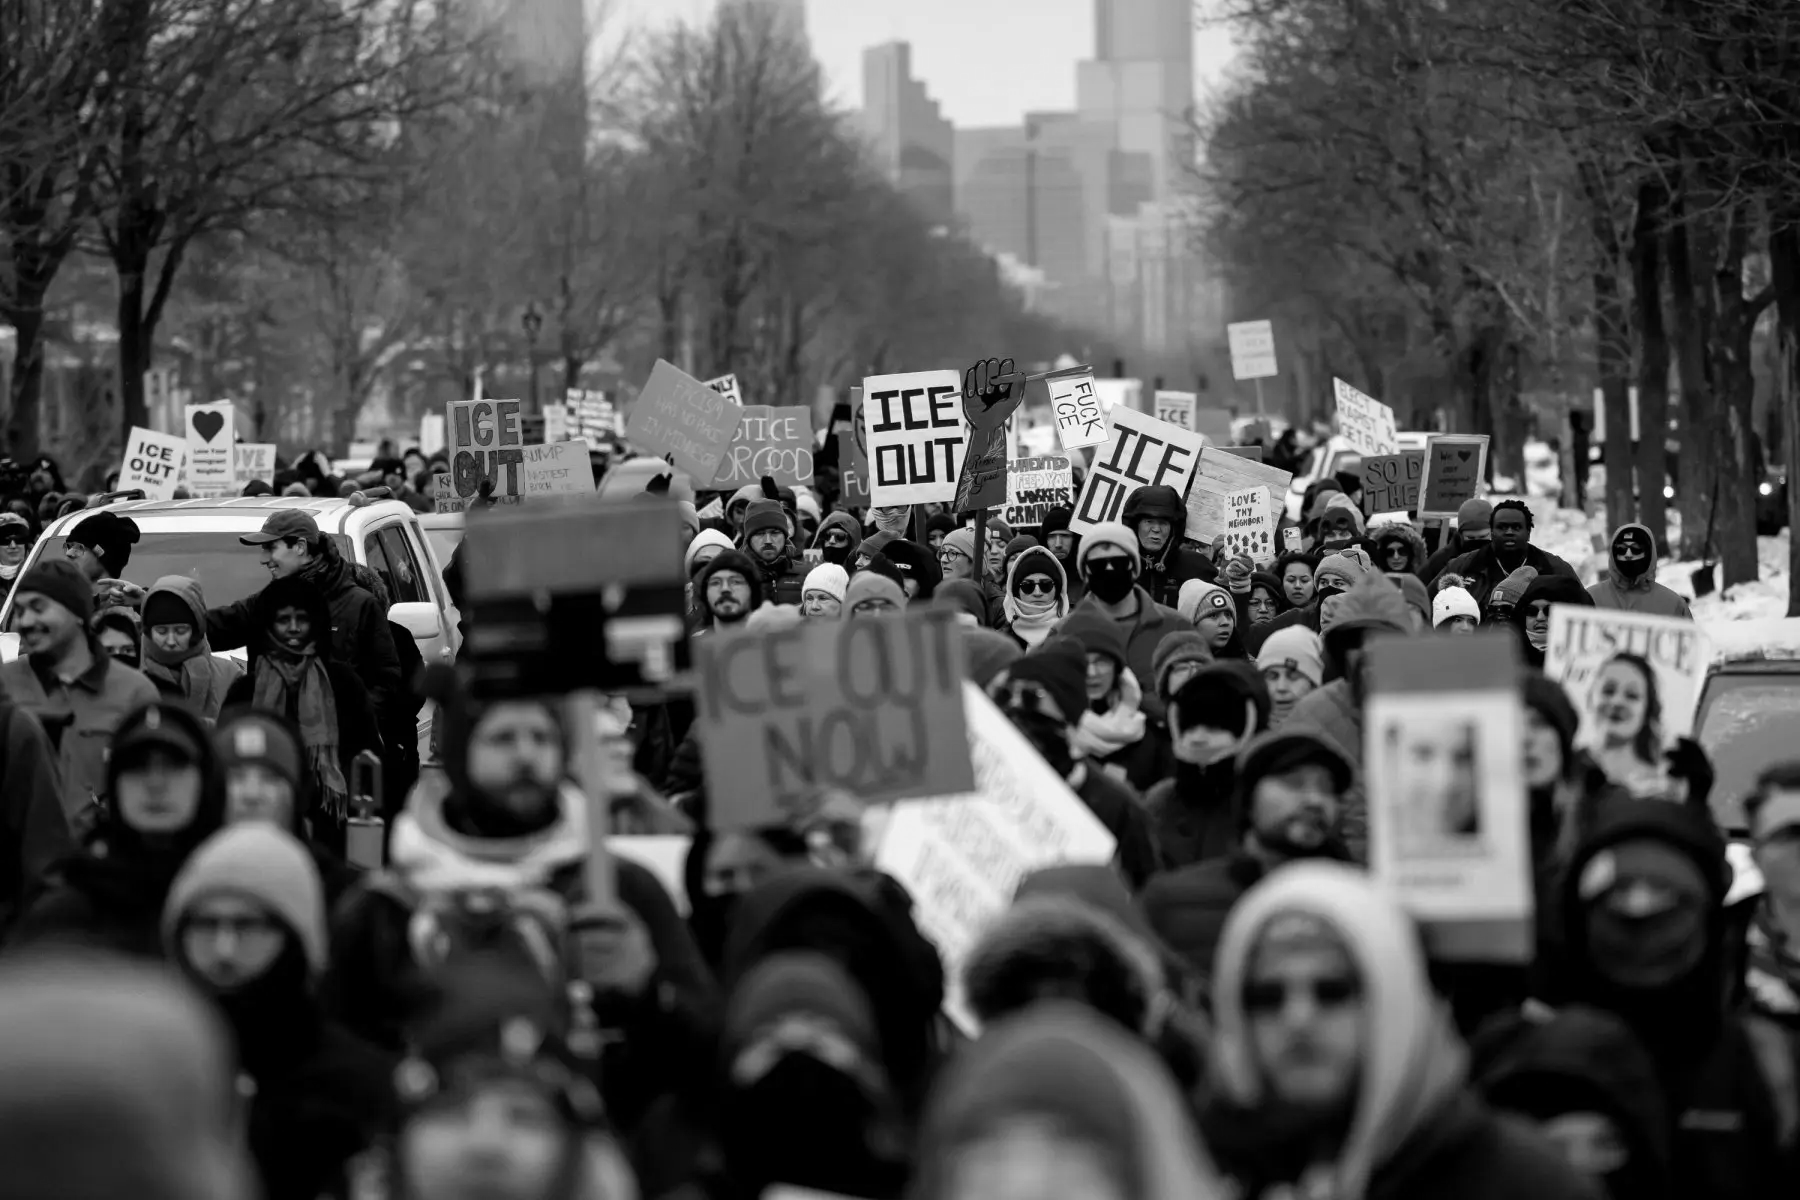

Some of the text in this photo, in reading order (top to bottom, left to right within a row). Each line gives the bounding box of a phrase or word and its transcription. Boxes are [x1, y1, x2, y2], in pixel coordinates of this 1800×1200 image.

[454, 401, 520, 447] ICE
[870, 385, 960, 433] ICE
[1054, 393, 1080, 430] ICE
[1075, 382, 1104, 437] FUCK
[129, 458, 175, 479] OUT
[138, 441, 174, 462] ICE
[453, 449, 524, 499] OUT
[875, 436, 964, 487] OUT
[1231, 492, 1257, 507] LOVE
[1235, 507, 1253, 518] THY
[837, 607, 958, 710] OUT
[1554, 617, 1698, 677] JUSTICE
[703, 629, 805, 723] ICE
[764, 708, 930, 798] NOW
